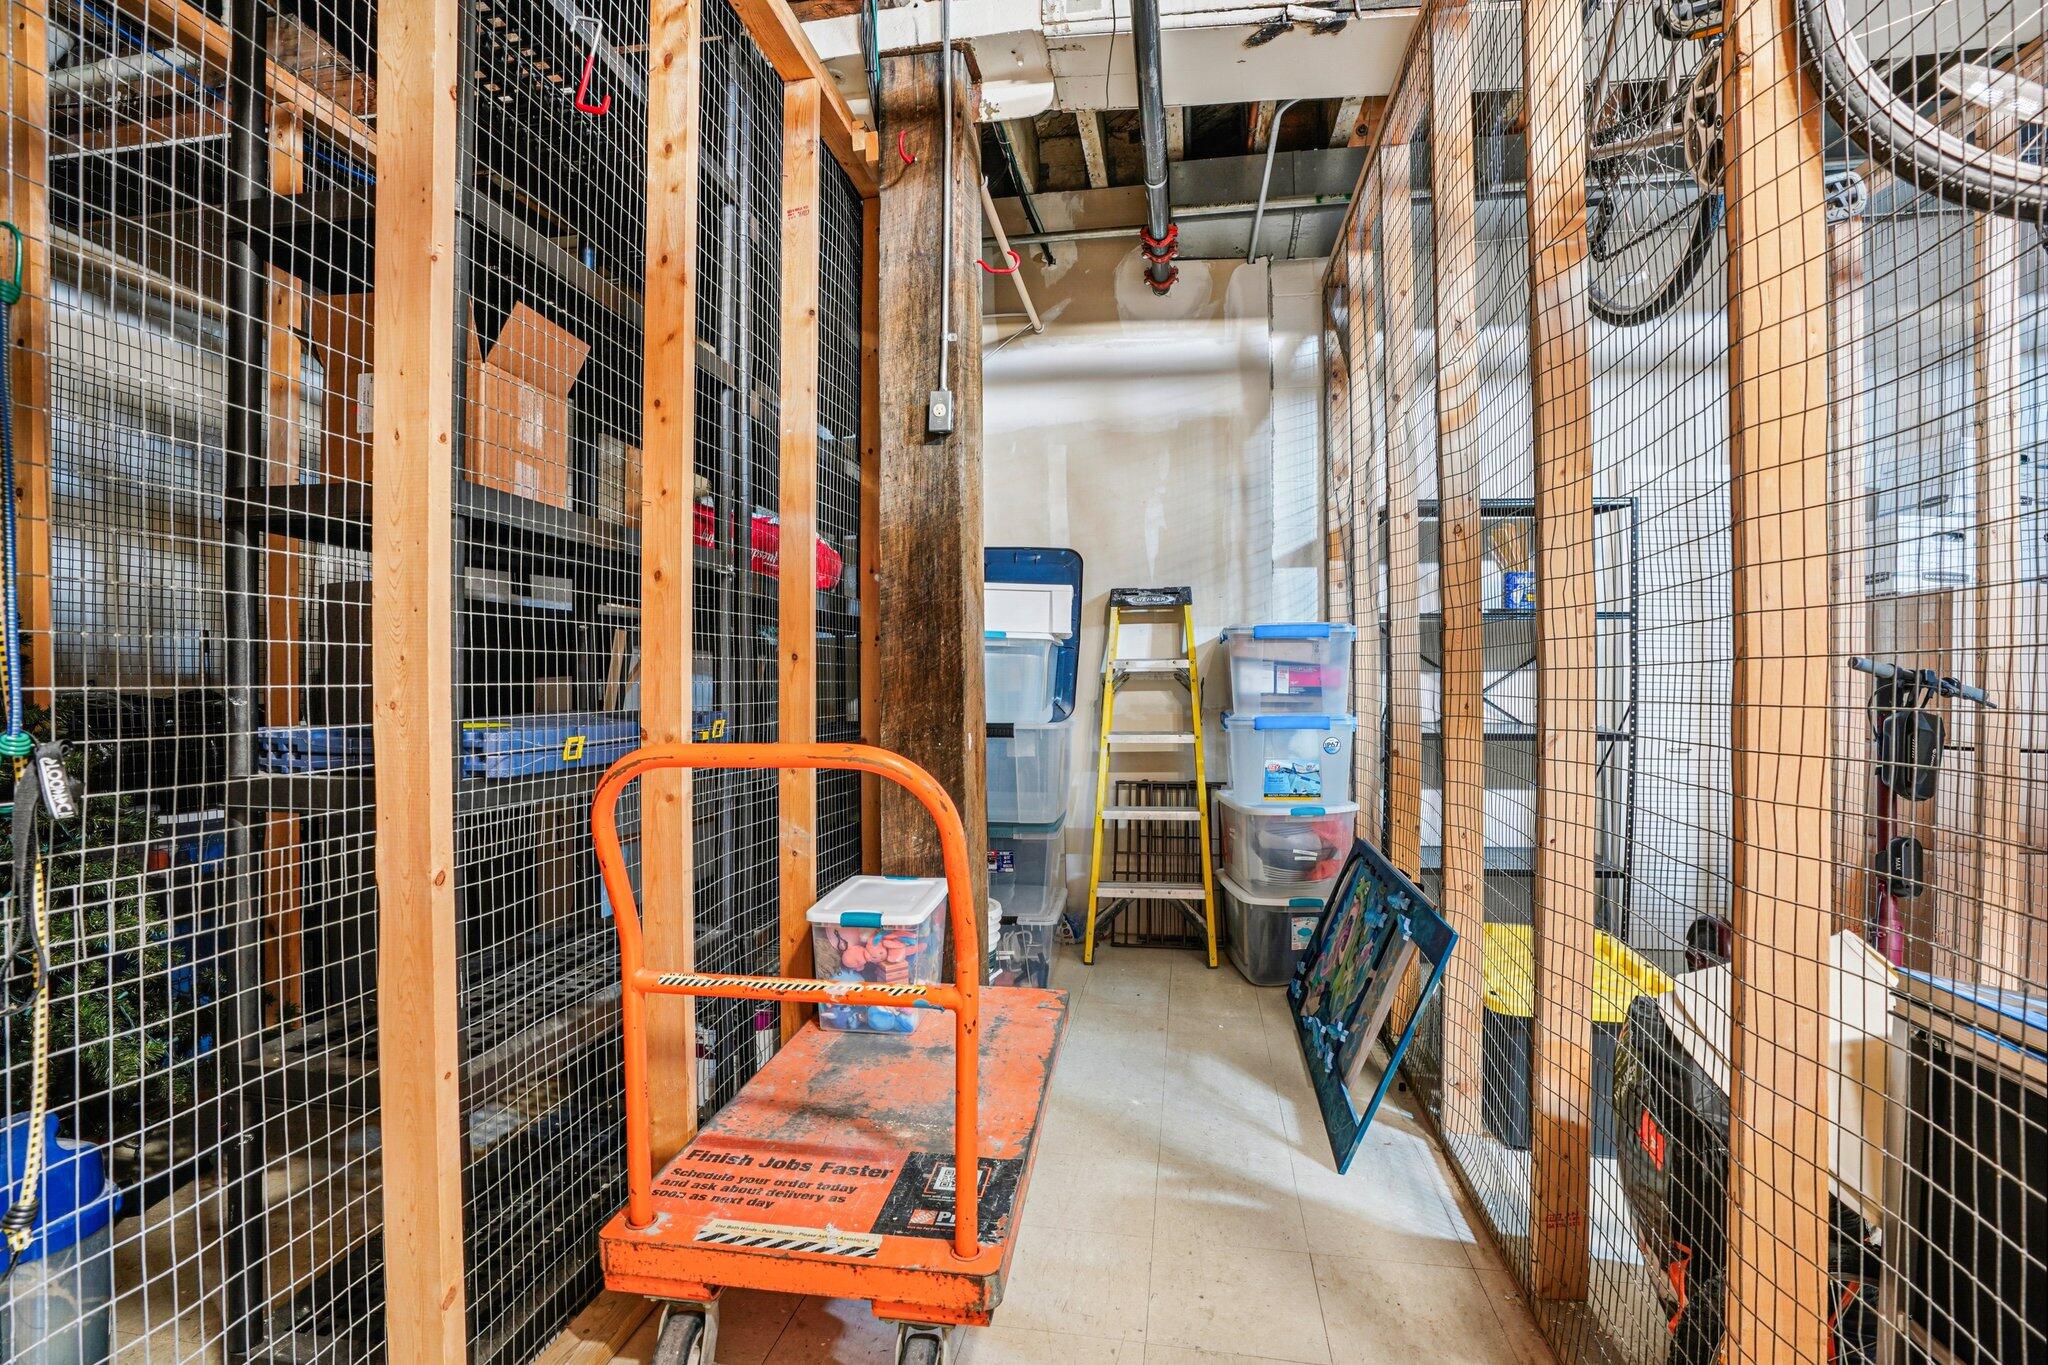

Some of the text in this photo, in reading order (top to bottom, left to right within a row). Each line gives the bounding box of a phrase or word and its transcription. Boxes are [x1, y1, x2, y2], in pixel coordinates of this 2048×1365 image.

[685, 1149, 894, 1179] Finish Jobs Faster
[660, 1179, 847, 1203] and ask about delivery as
[671, 1167, 858, 1195] Schedule your order today
[651, 1189, 775, 1209] soon as next day
